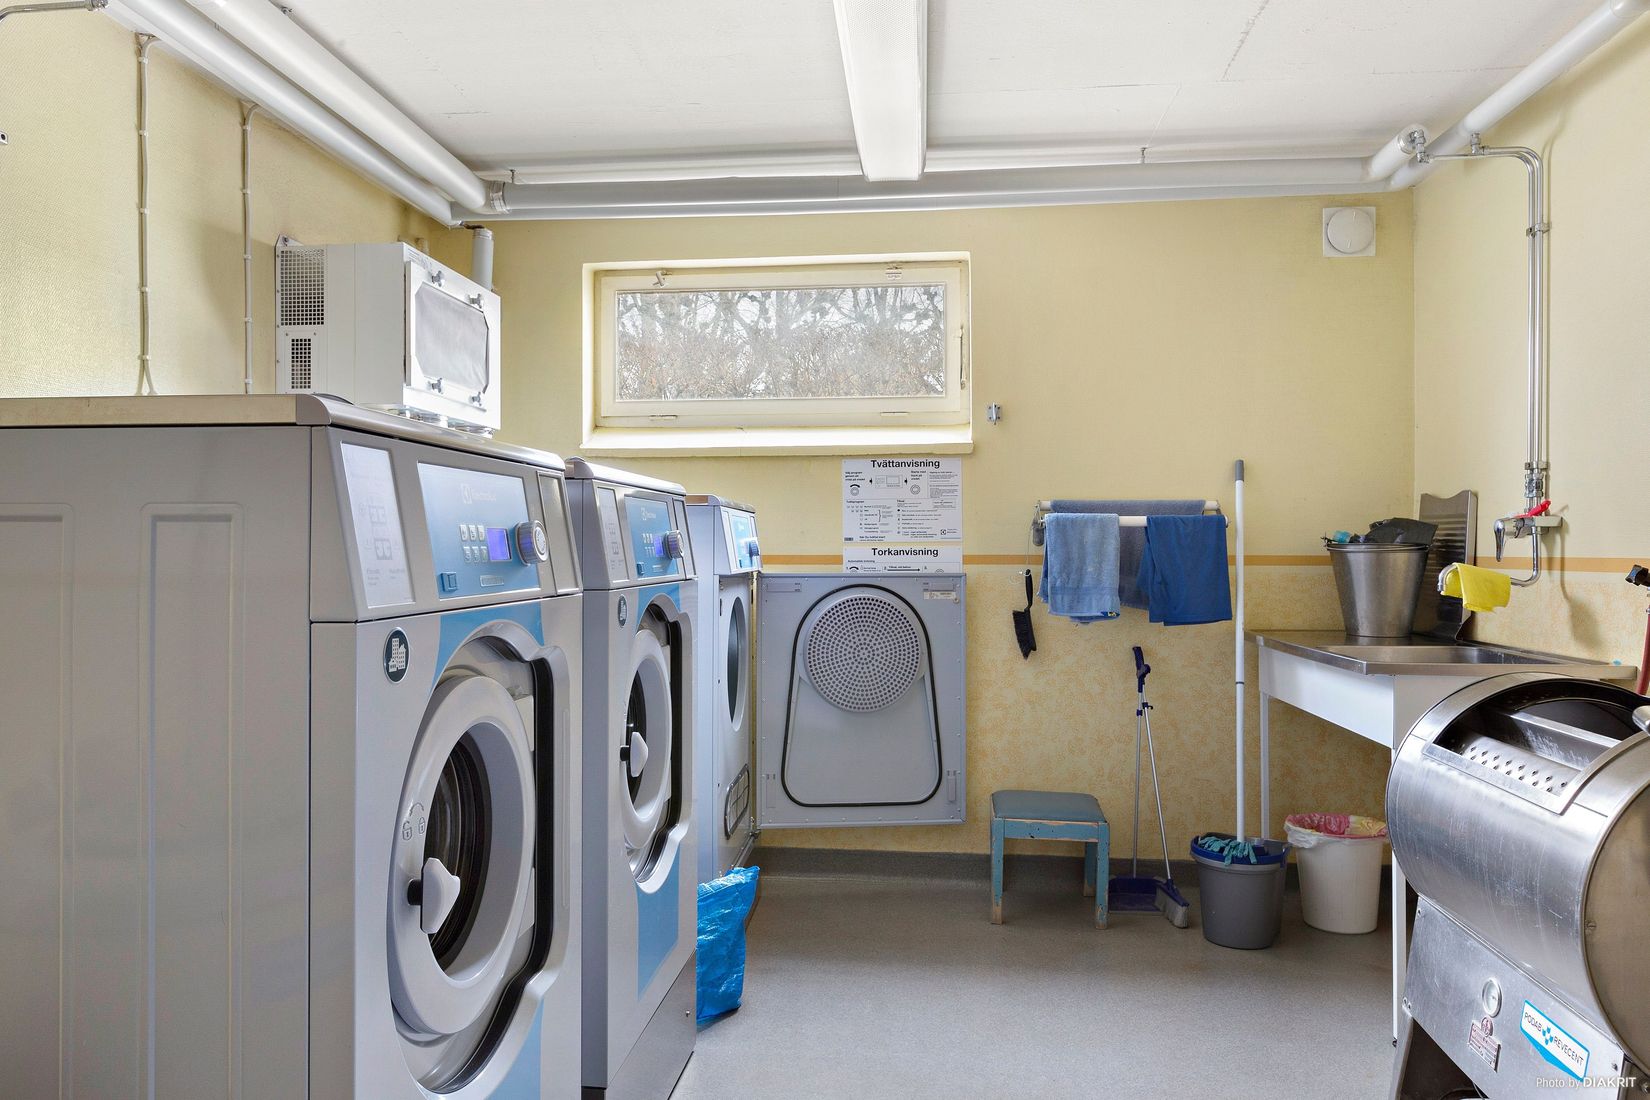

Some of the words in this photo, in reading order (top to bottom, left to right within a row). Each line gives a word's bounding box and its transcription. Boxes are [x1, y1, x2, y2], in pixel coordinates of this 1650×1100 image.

[870, 459, 940, 469] Tvättanvisning
[872, 547, 939, 557] Torkanvisning
[1524, 1011, 1543, 1032] PODAB
[1553, 1035, 1585, 1066] REVECENT
